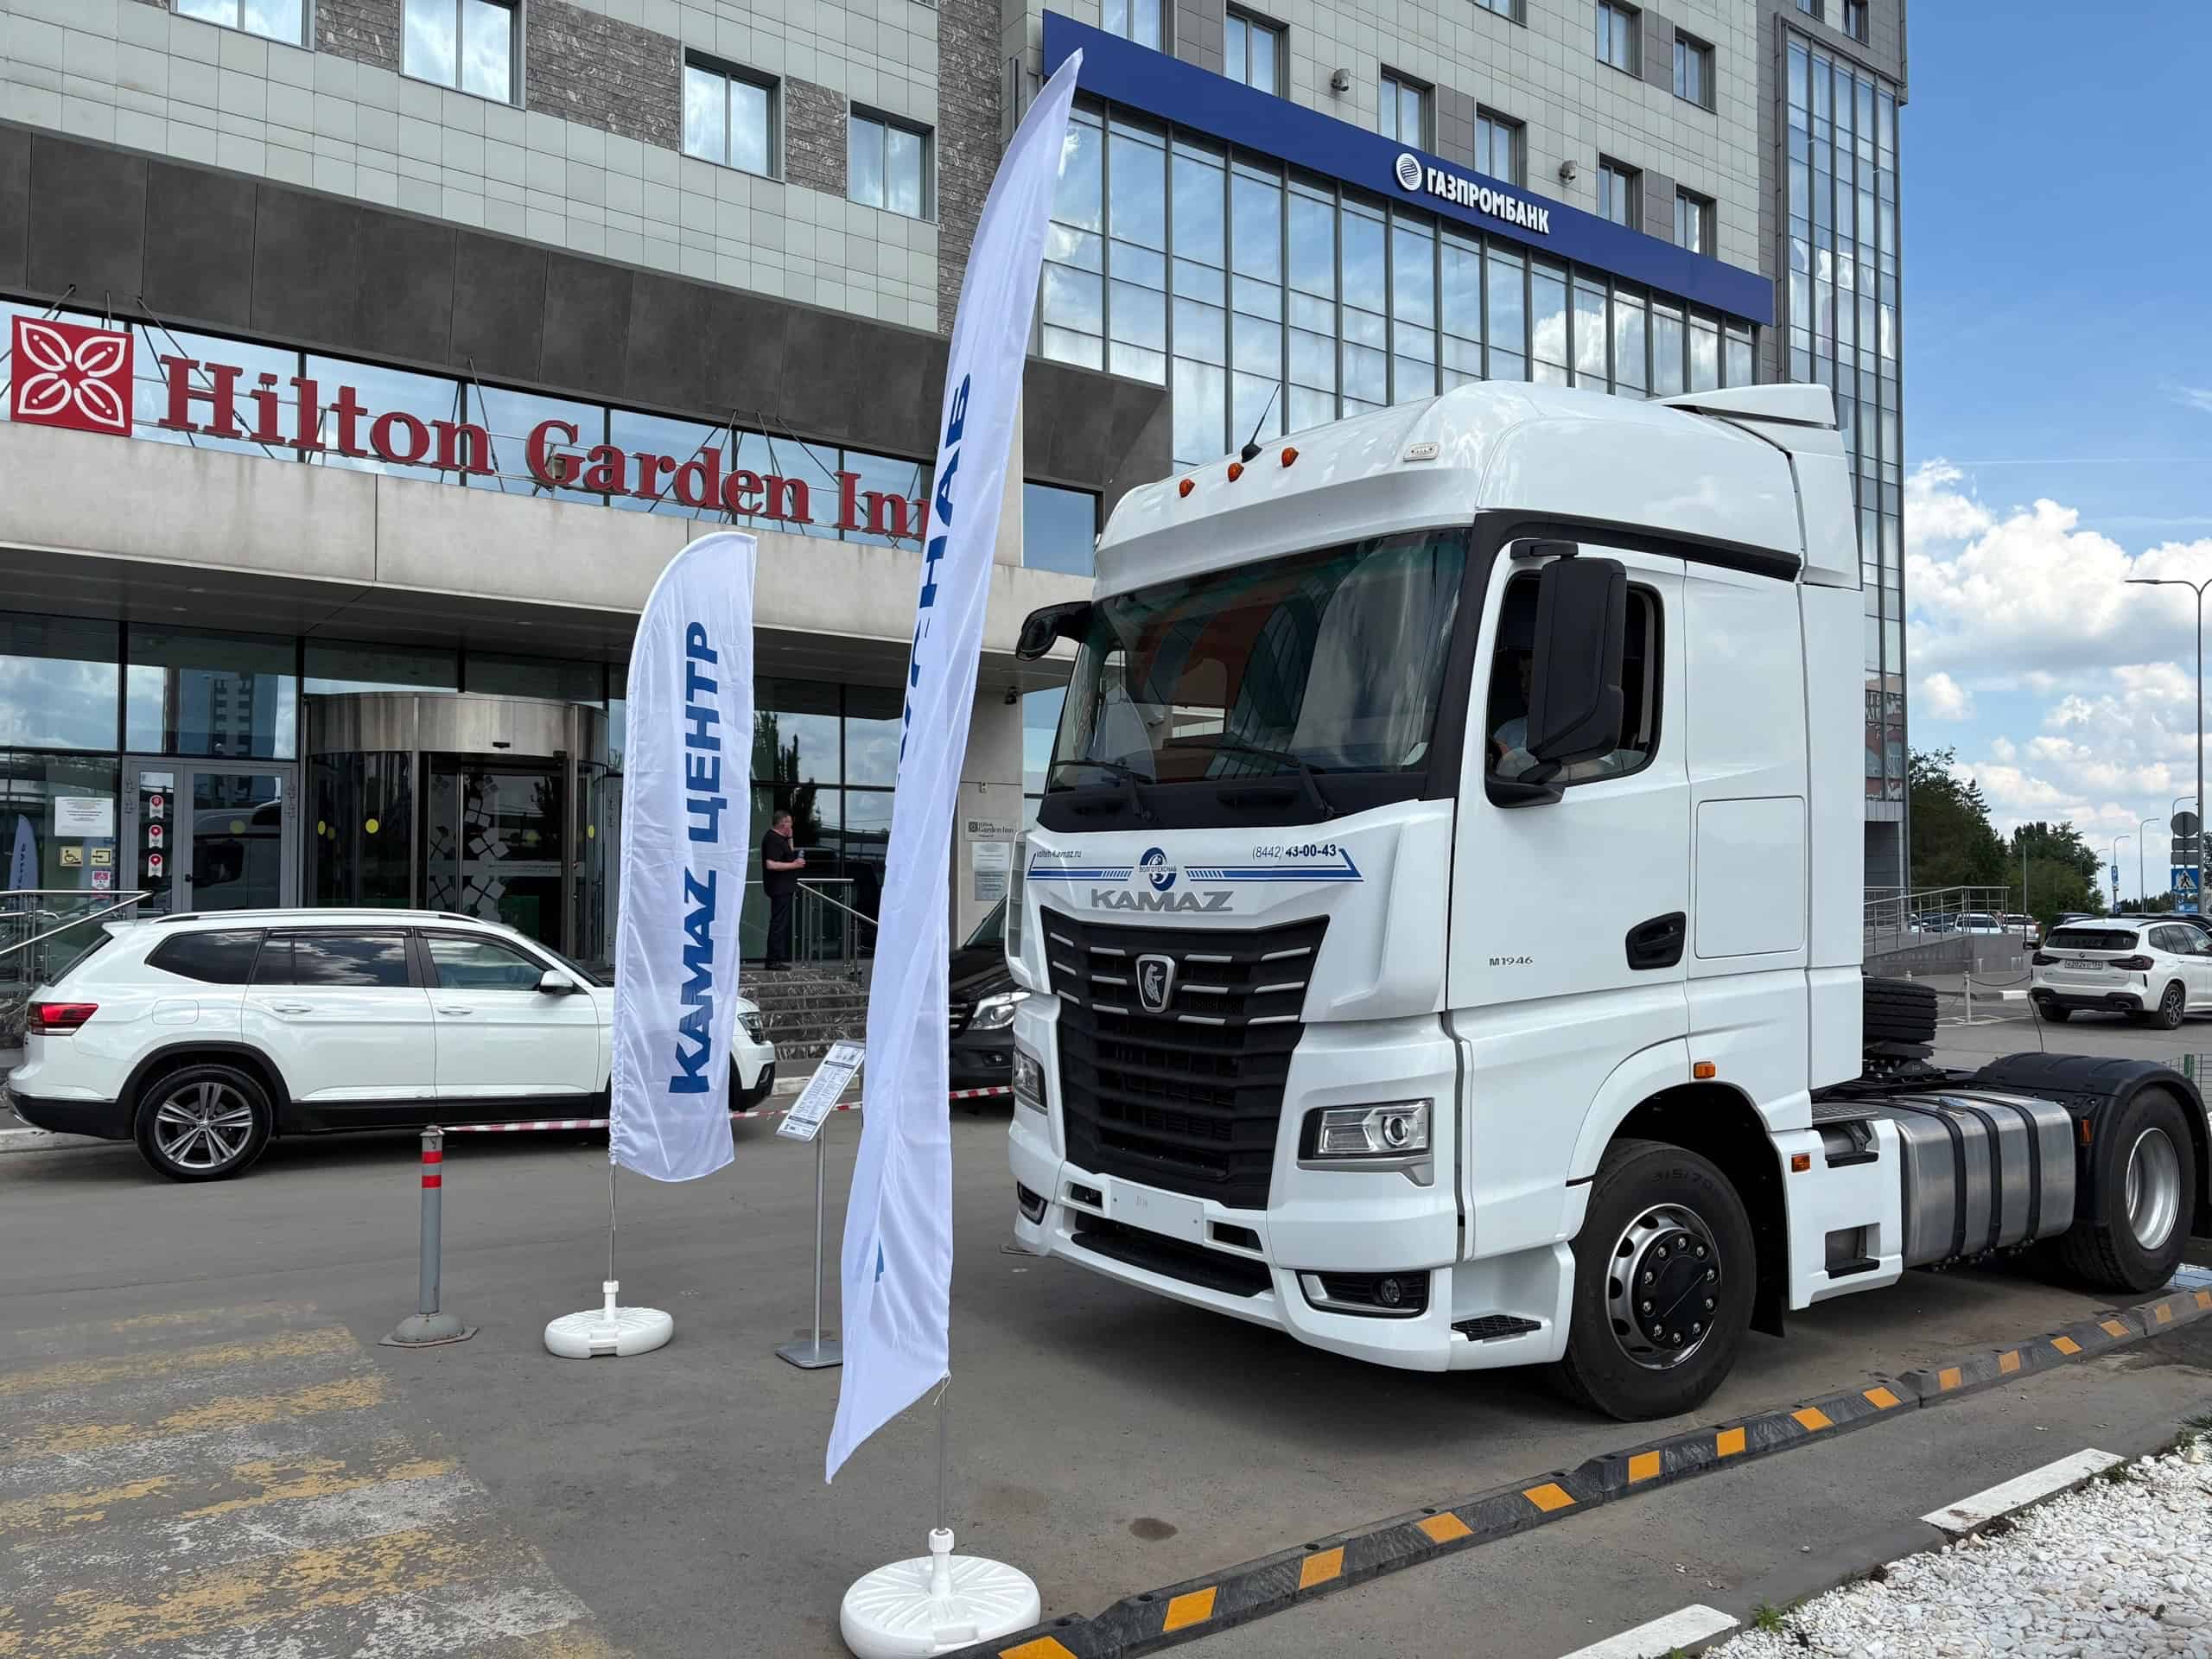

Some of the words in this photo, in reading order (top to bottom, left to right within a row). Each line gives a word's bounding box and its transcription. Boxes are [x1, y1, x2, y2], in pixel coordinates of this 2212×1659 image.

[1427, 167, 1549, 234] ГАЗПРОМБАНК
[158, 353, 498, 476] Hilton
[526, 419, 814, 524] Garden
[685, 621, 728, 843] ЦЕНТР
[1252, 845, 1284, 860] (8442)
[1285, 843, 1337, 857] 43-00-43
[1091, 889, 1234, 912] KAMAZ
[669, 866, 717, 1093] KAMAZ
[1489, 956, 1534, 966] M1946
